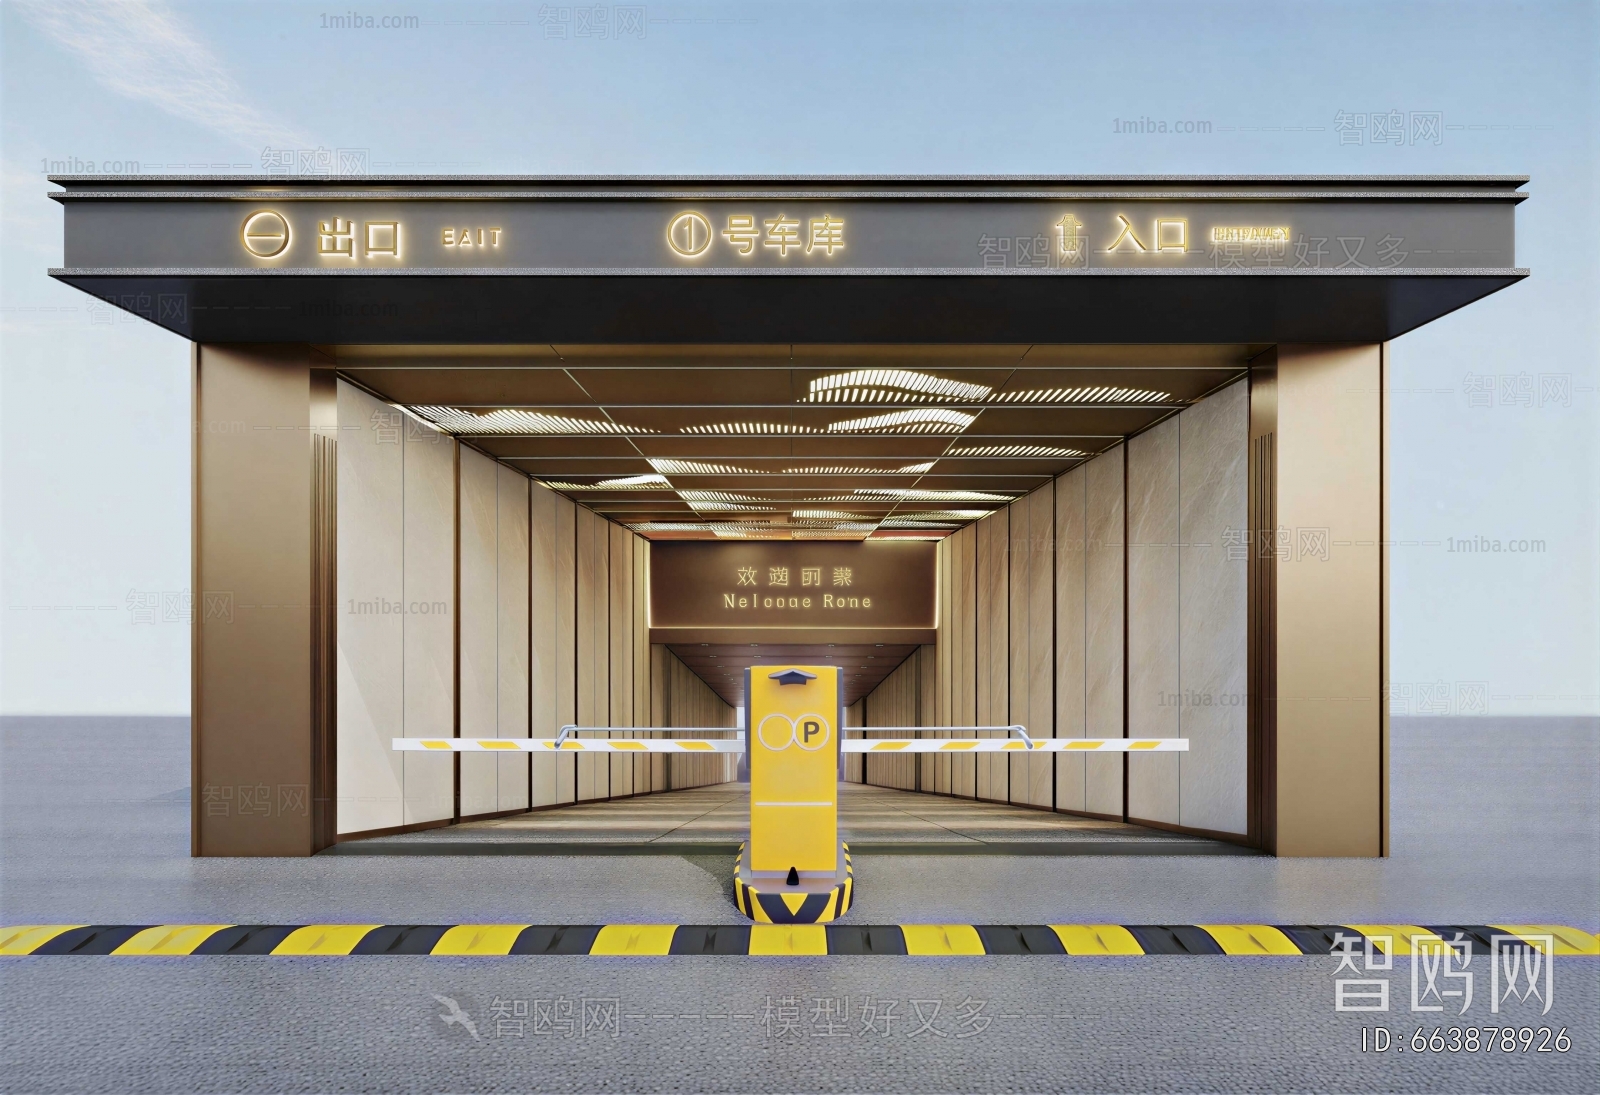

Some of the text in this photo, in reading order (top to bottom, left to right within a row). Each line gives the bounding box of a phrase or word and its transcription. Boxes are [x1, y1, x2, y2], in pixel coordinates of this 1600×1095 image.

[317, 216, 400, 258] 出口
[1107, 214, 1189, 254] 入口
[803, 721, 820, 743] P
